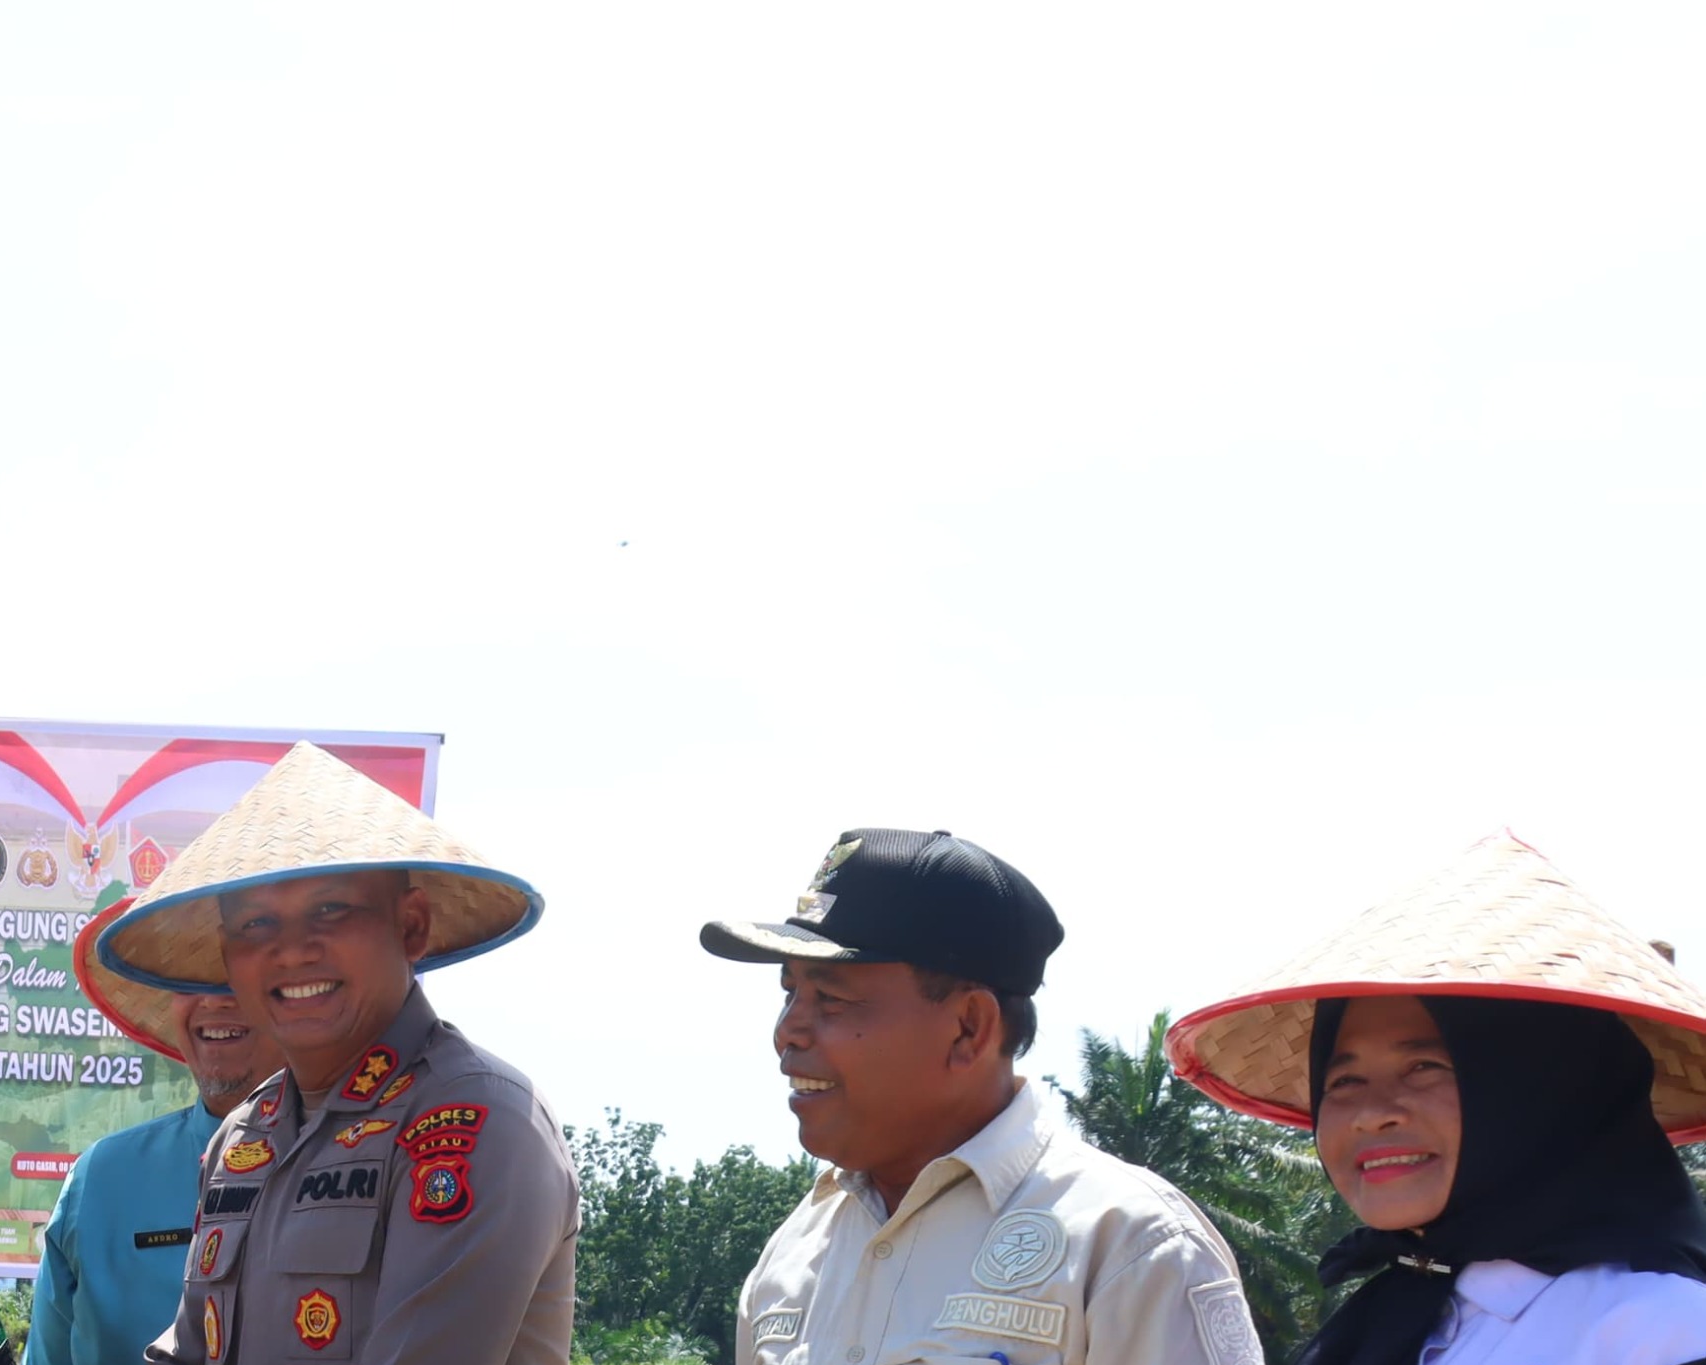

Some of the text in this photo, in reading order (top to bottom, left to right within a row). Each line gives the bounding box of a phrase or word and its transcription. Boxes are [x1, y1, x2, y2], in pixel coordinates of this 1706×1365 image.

[80, 1056, 143, 1085] 2025
[405, 1109, 476, 1140] POLRES
[419, 1138, 462, 1151] RIAU
[296, 1168, 379, 1204] POLRI
[947, 1299, 1056, 1336] PENGHULU
